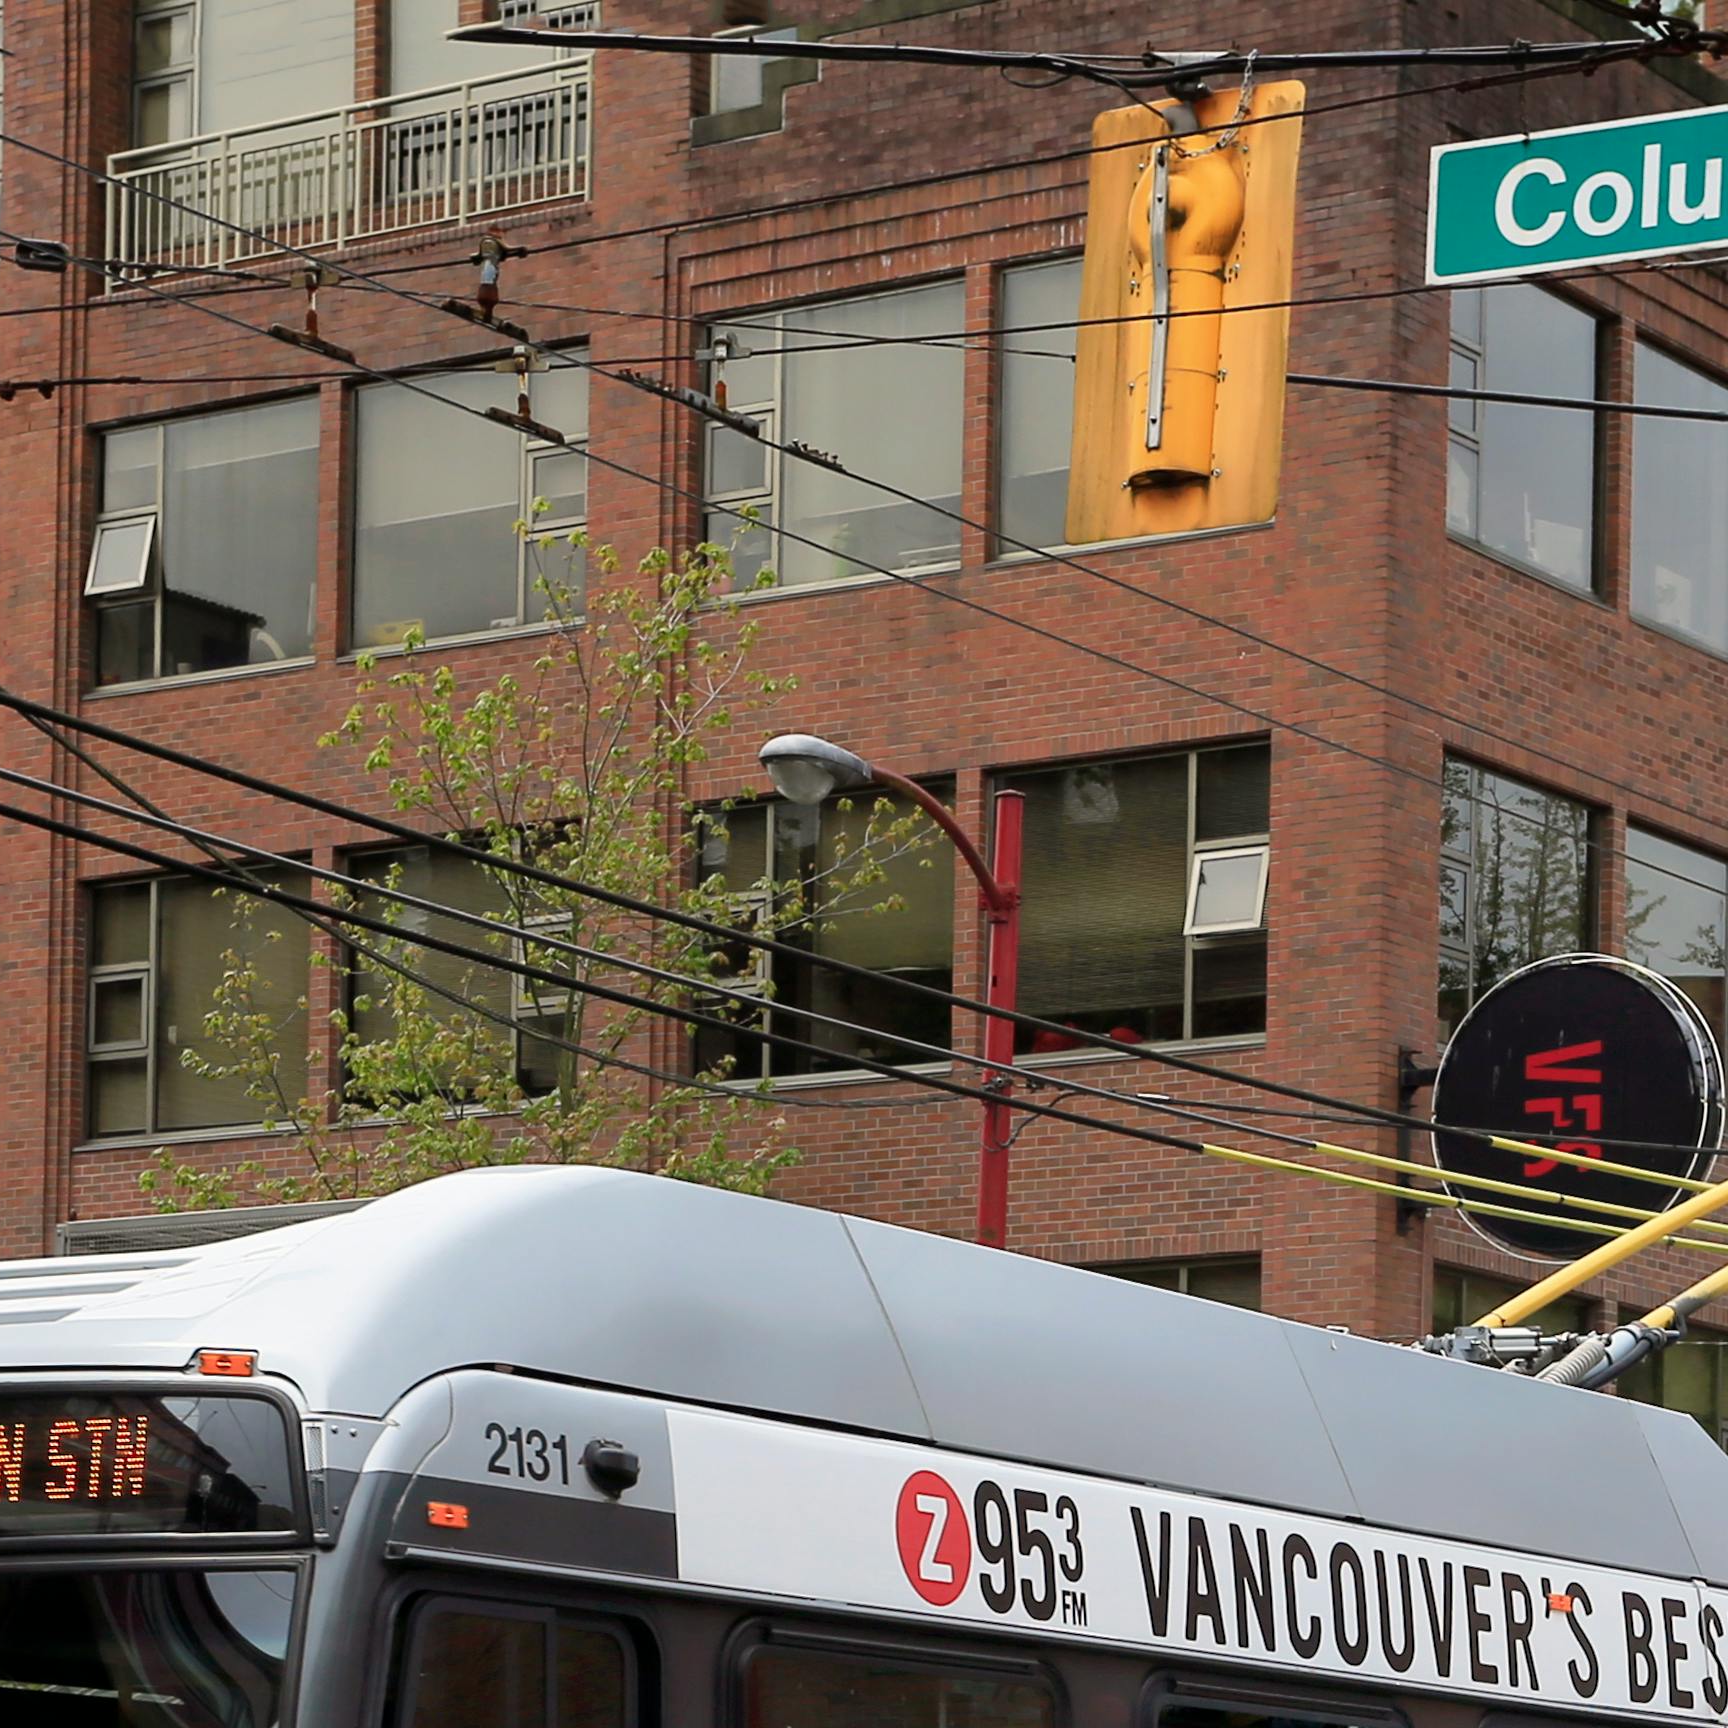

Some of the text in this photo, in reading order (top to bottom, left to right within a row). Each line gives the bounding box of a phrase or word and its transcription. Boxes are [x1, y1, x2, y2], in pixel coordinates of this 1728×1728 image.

[1524, 1040, 1603, 1178] VFS
[45, 1415, 148, 1501] STN
[485, 1421, 570, 1486] 2131
[1130, 1506, 1599, 1699] VANCOUVER'S
